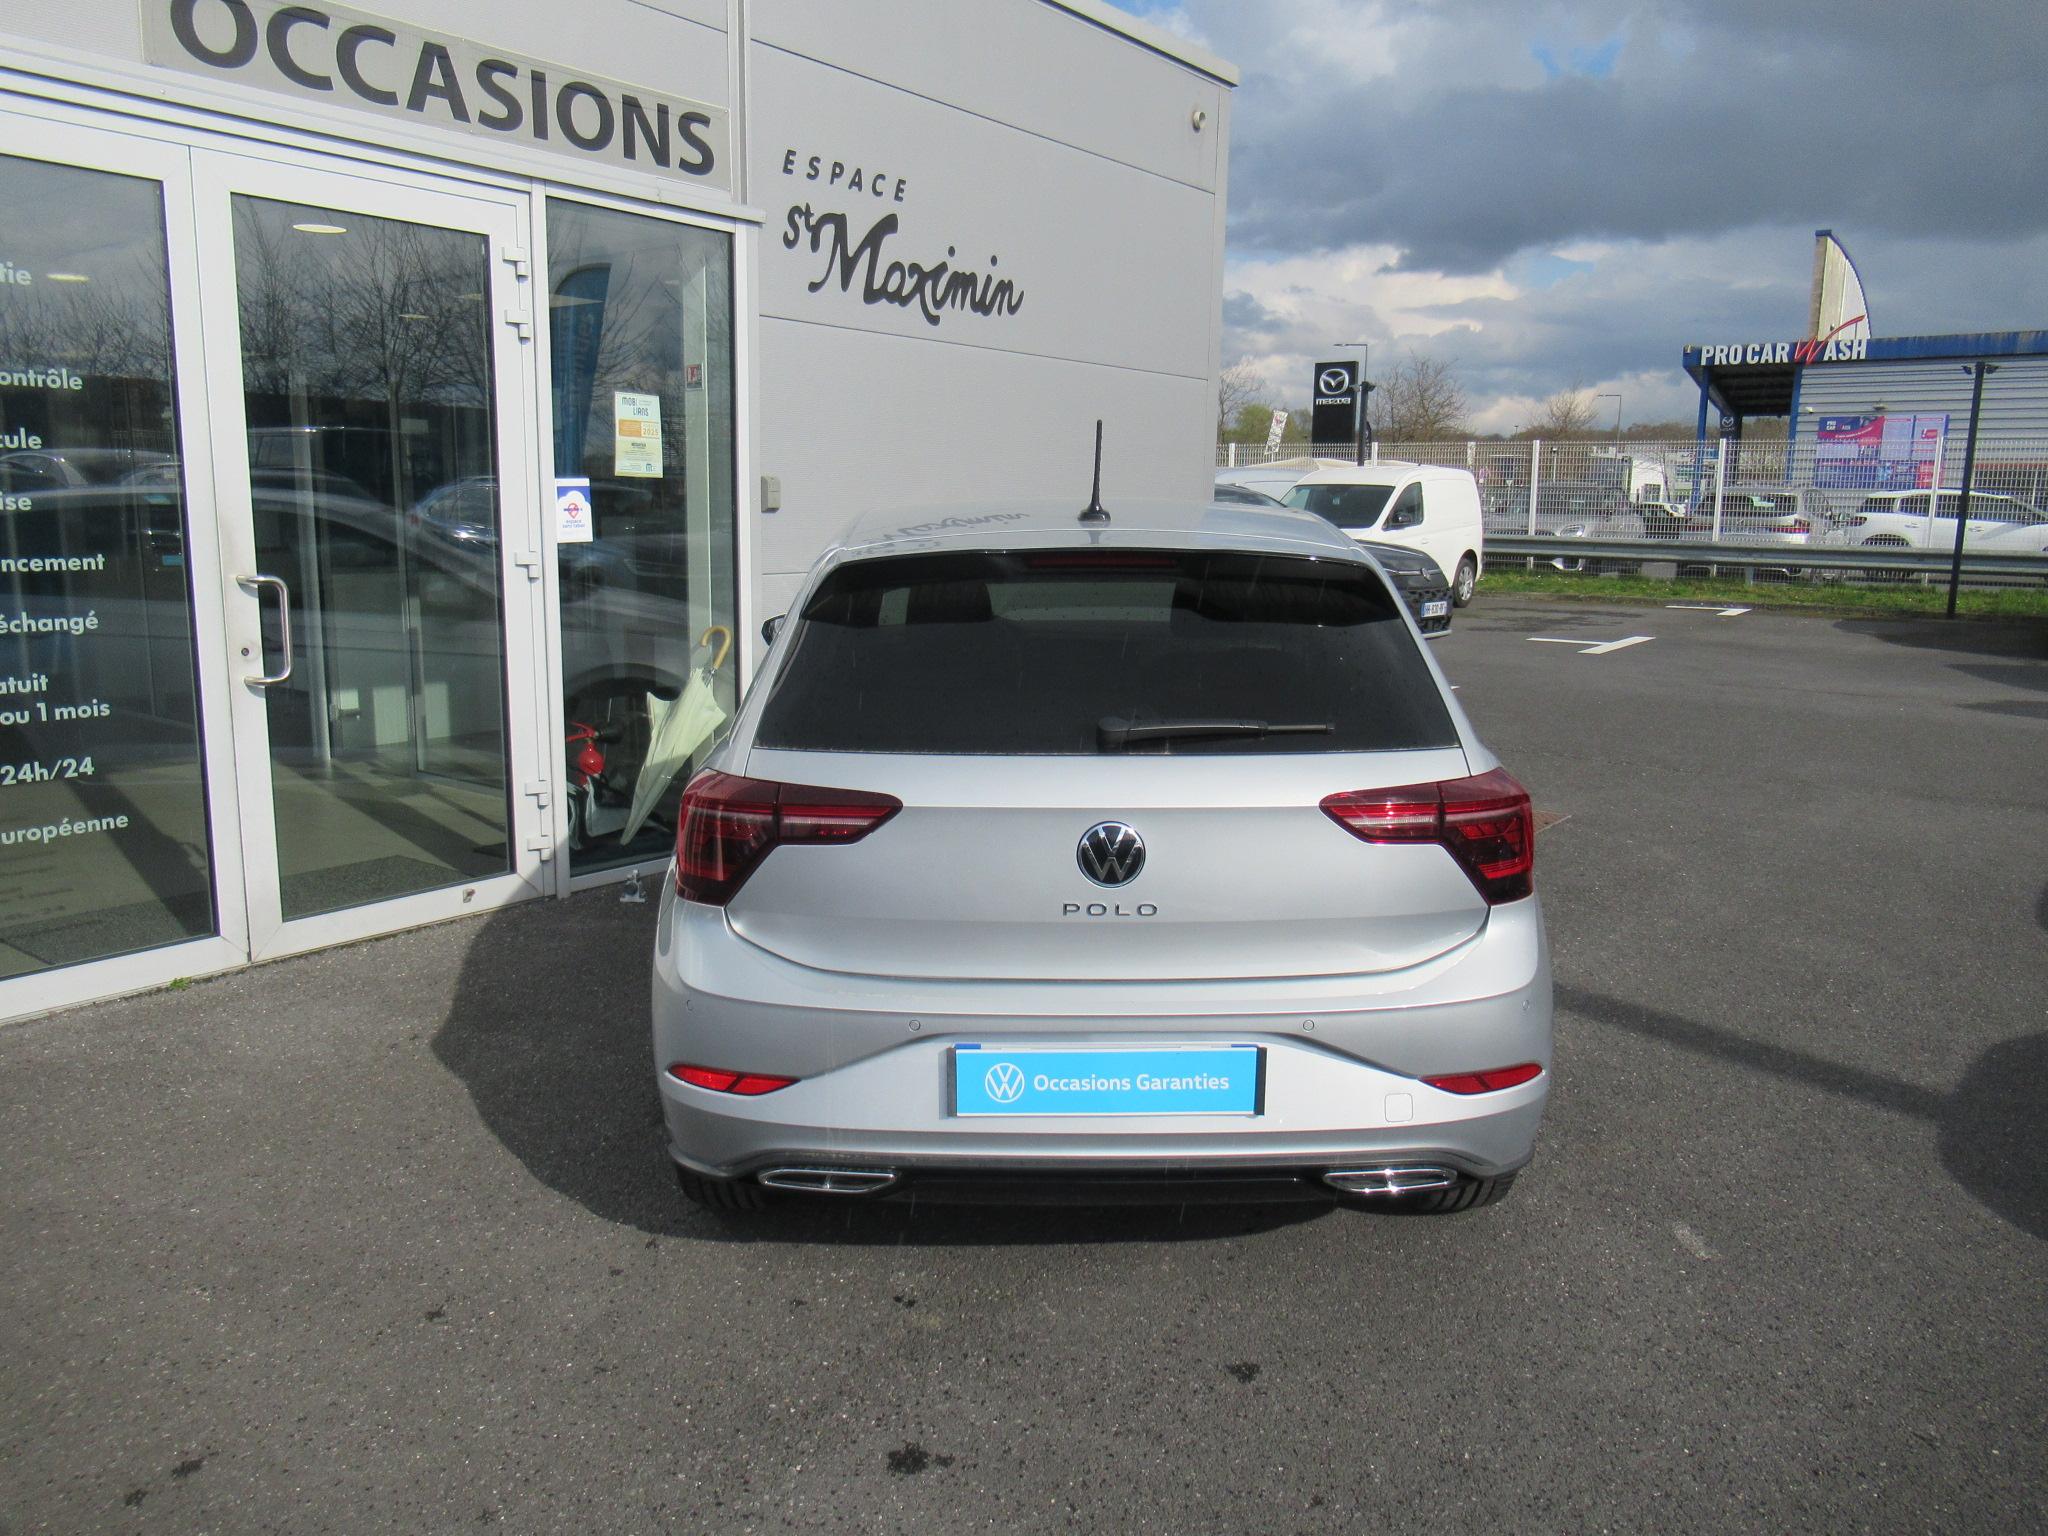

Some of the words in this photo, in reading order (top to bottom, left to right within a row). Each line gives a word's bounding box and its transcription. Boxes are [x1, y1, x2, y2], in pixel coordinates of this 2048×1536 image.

[169, 0, 715, 176] OCCASIONS
[782, 149, 906, 202] ESPACE
[807, 213, 1024, 326] Maximin
[0, 368, 83, 390] ontrôle
[0, 553, 105, 573] ncement
[0, 610, 99, 636] échangé
[0, 709, 30, 726] ou
[36, 702, 48, 722] 1
[54, 698, 111, 721] mois
[0, 756, 95, 786] 24h/24
[1, 814, 129, 844] uropéenne
[1062, 903, 1158, 917] POLO
[1033, 1073, 1131, 1092] Occasions
[1136, 1072, 1230, 1091] Garanties
